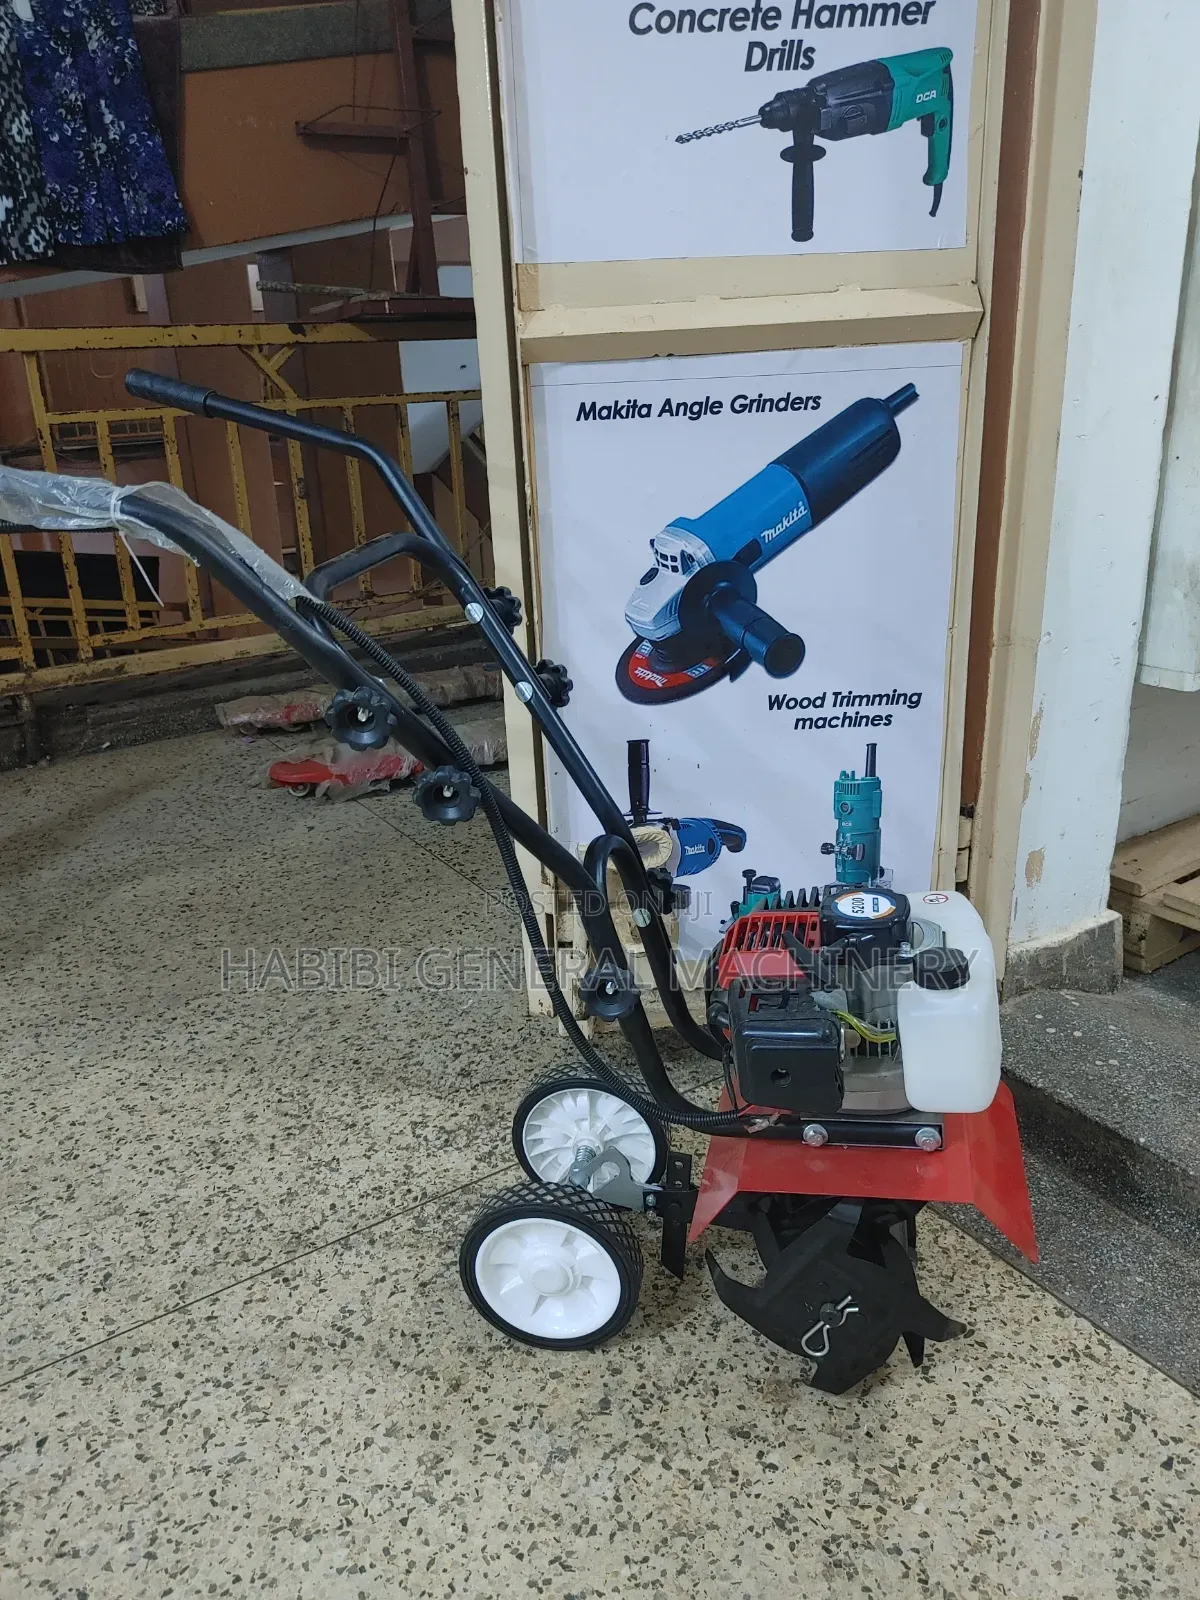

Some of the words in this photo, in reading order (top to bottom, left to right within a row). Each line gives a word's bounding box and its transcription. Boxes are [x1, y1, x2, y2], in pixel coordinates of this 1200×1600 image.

[629, 0, 782, 35] Concrete
[791, 0, 936, 30] Hammer
[744, 39, 816, 72] Drills
[915, 89, 937, 104] DCA
[576, 398, 653, 422] Makita
[657, 396, 724, 421] Angle
[729, 392, 822, 414] Grinders
[768, 691, 827, 711] Wood
[831, 688, 923, 709] Trimming
[793, 711, 894, 730] machines
[851, 897, 865, 914] 5200
